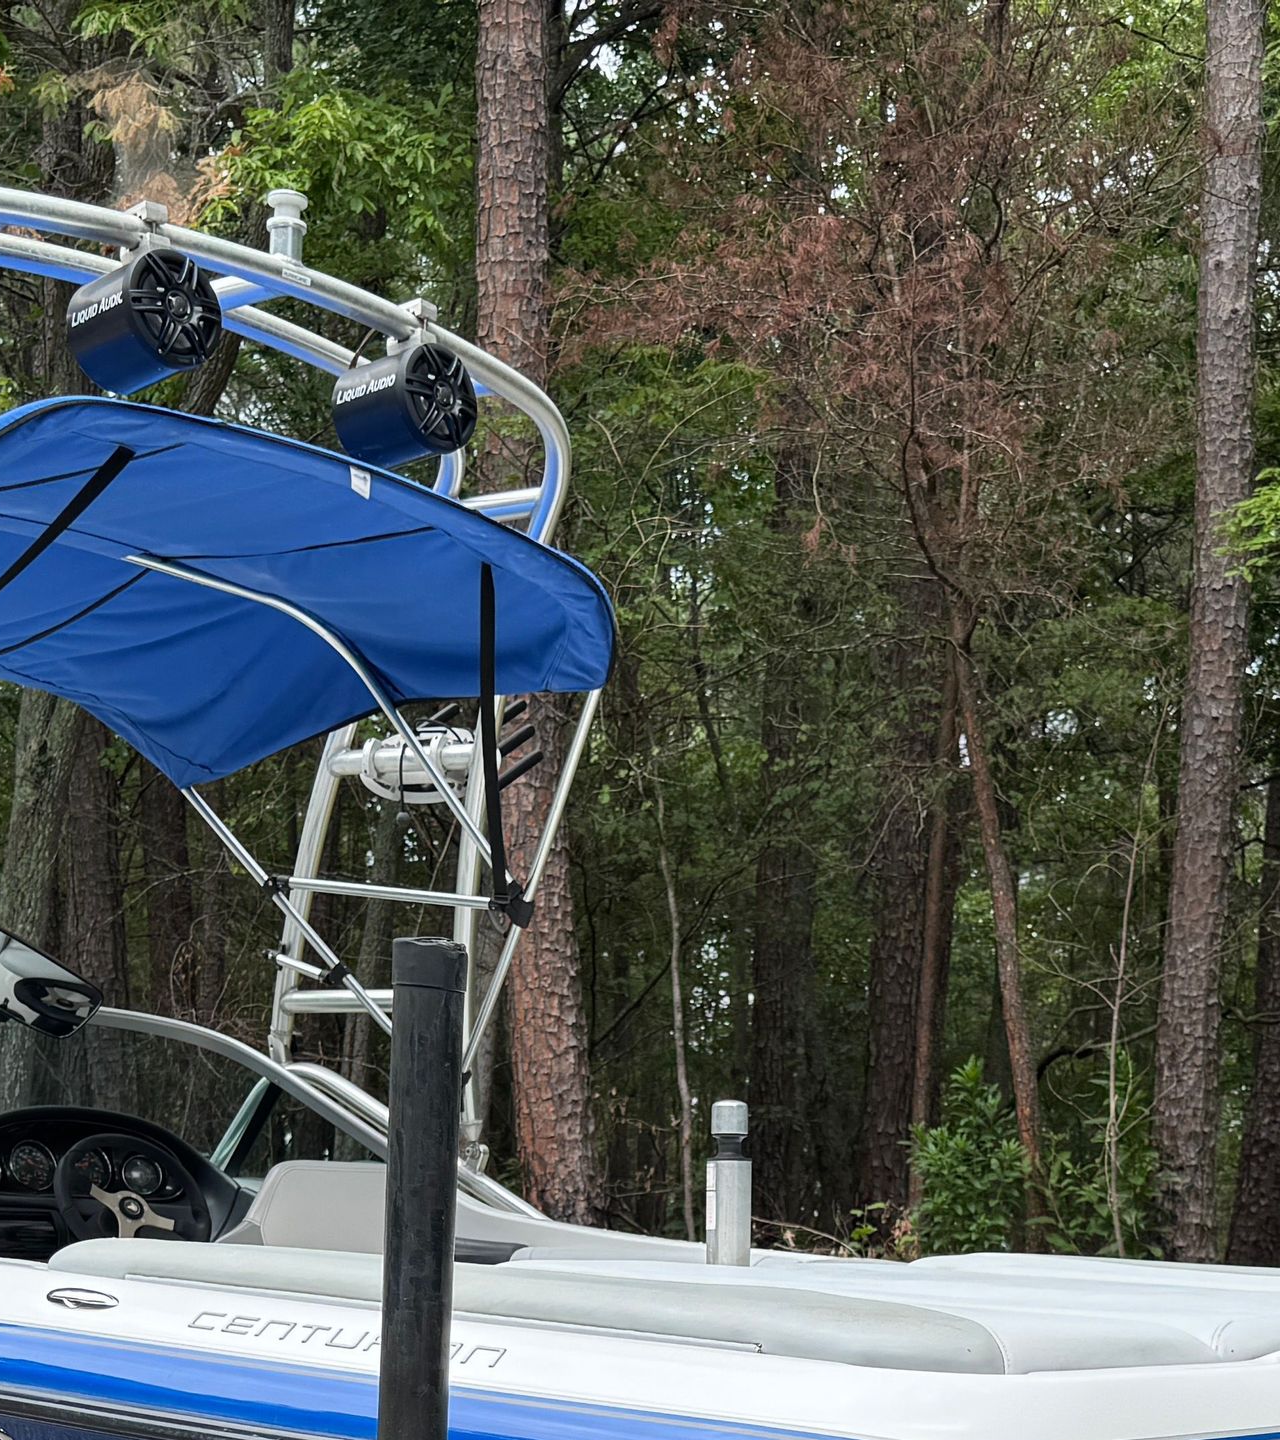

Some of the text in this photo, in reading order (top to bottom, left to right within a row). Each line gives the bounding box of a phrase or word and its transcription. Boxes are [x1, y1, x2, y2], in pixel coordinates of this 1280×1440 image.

[71, 303, 99, 328] LIQUID
[336, 373, 396, 405] LIQUID AUDIO
